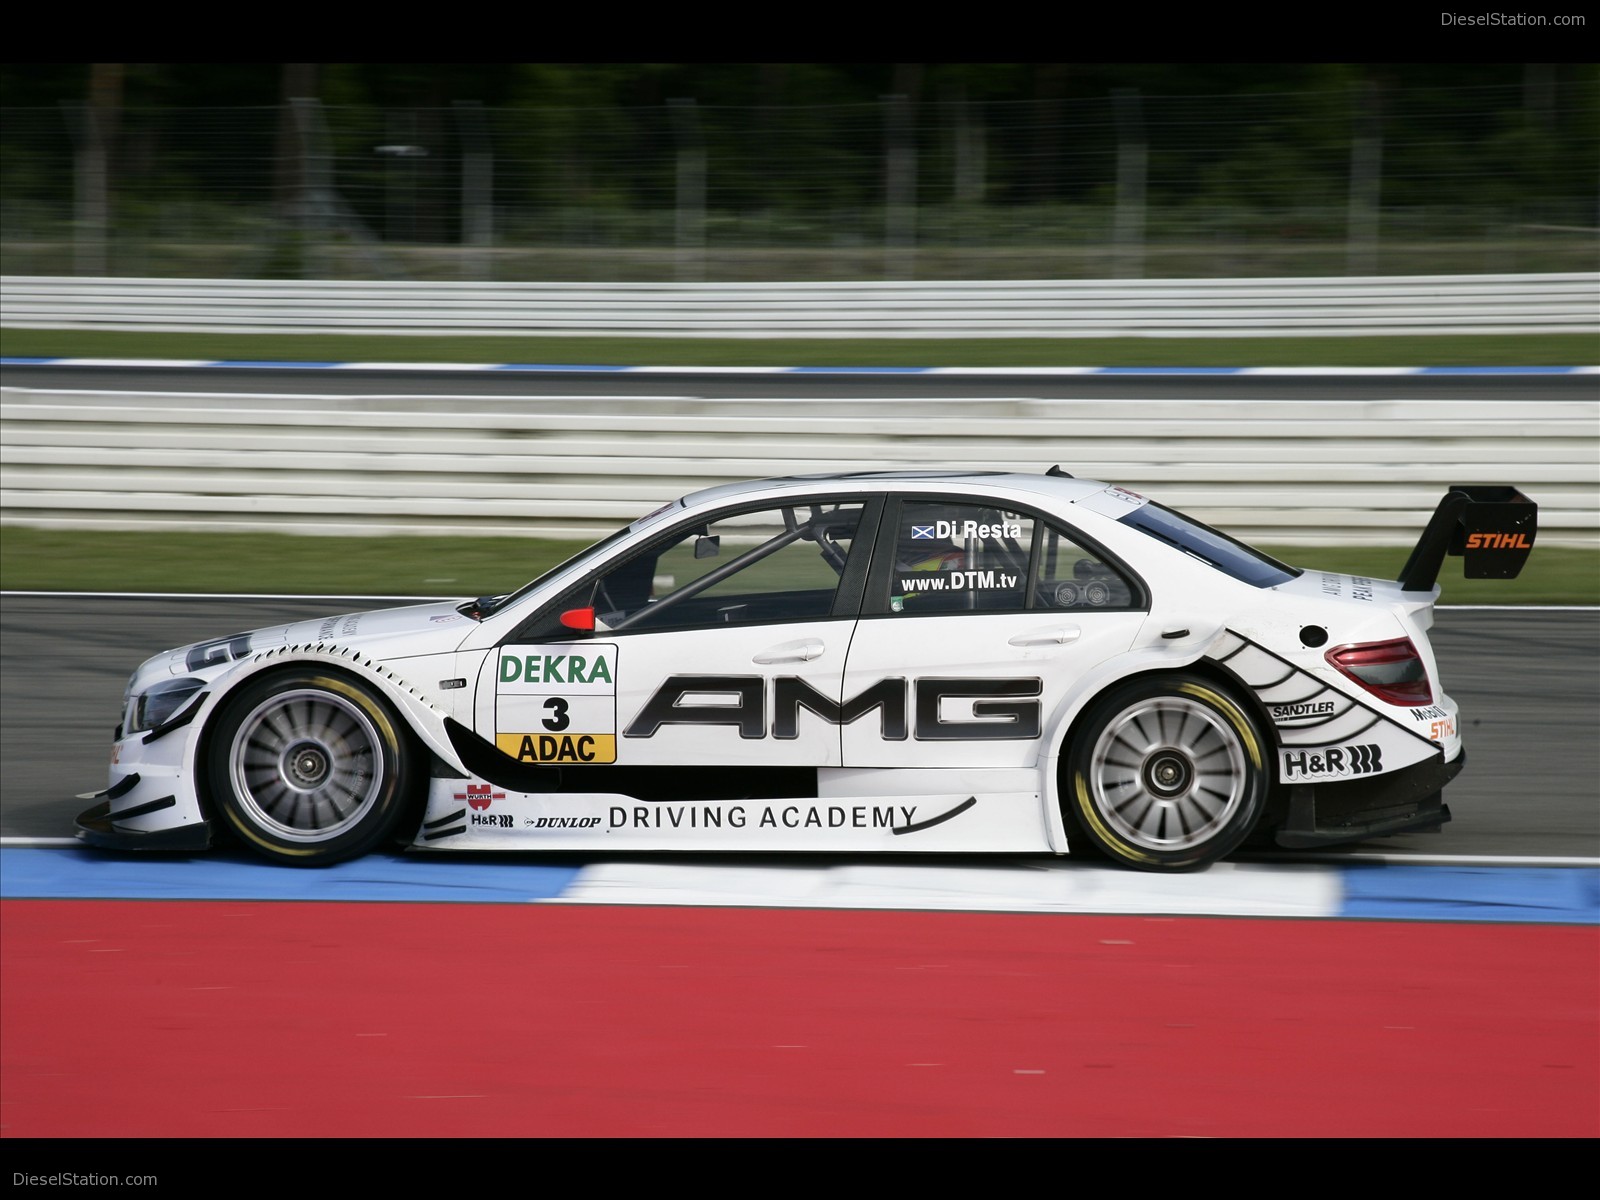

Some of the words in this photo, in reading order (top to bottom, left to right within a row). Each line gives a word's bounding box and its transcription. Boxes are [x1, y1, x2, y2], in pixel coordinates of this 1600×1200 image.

[936, 520, 957, 539] Di
[964, 520, 1022, 539] Resta
[1465, 533, 1531, 549] STIHL
[901, 570, 1018, 592] www.DTM.tv
[499, 654, 613, 684] DEKRA
[541, 697, 571, 732] 3
[622, 673, 1044, 741] AMG
[1273, 701, 1335, 718] SANDTLER
[1430, 719, 1455, 740] STIHL
[517, 735, 596, 762] ADAC
[1285, 748, 1346, 777] H&R
[471, 814, 498, 826] H&R
[535, 817, 602, 828] DUNLOP
[609, 806, 747, 828] DRIVING
[759, 805, 918, 829] ACADEMY
